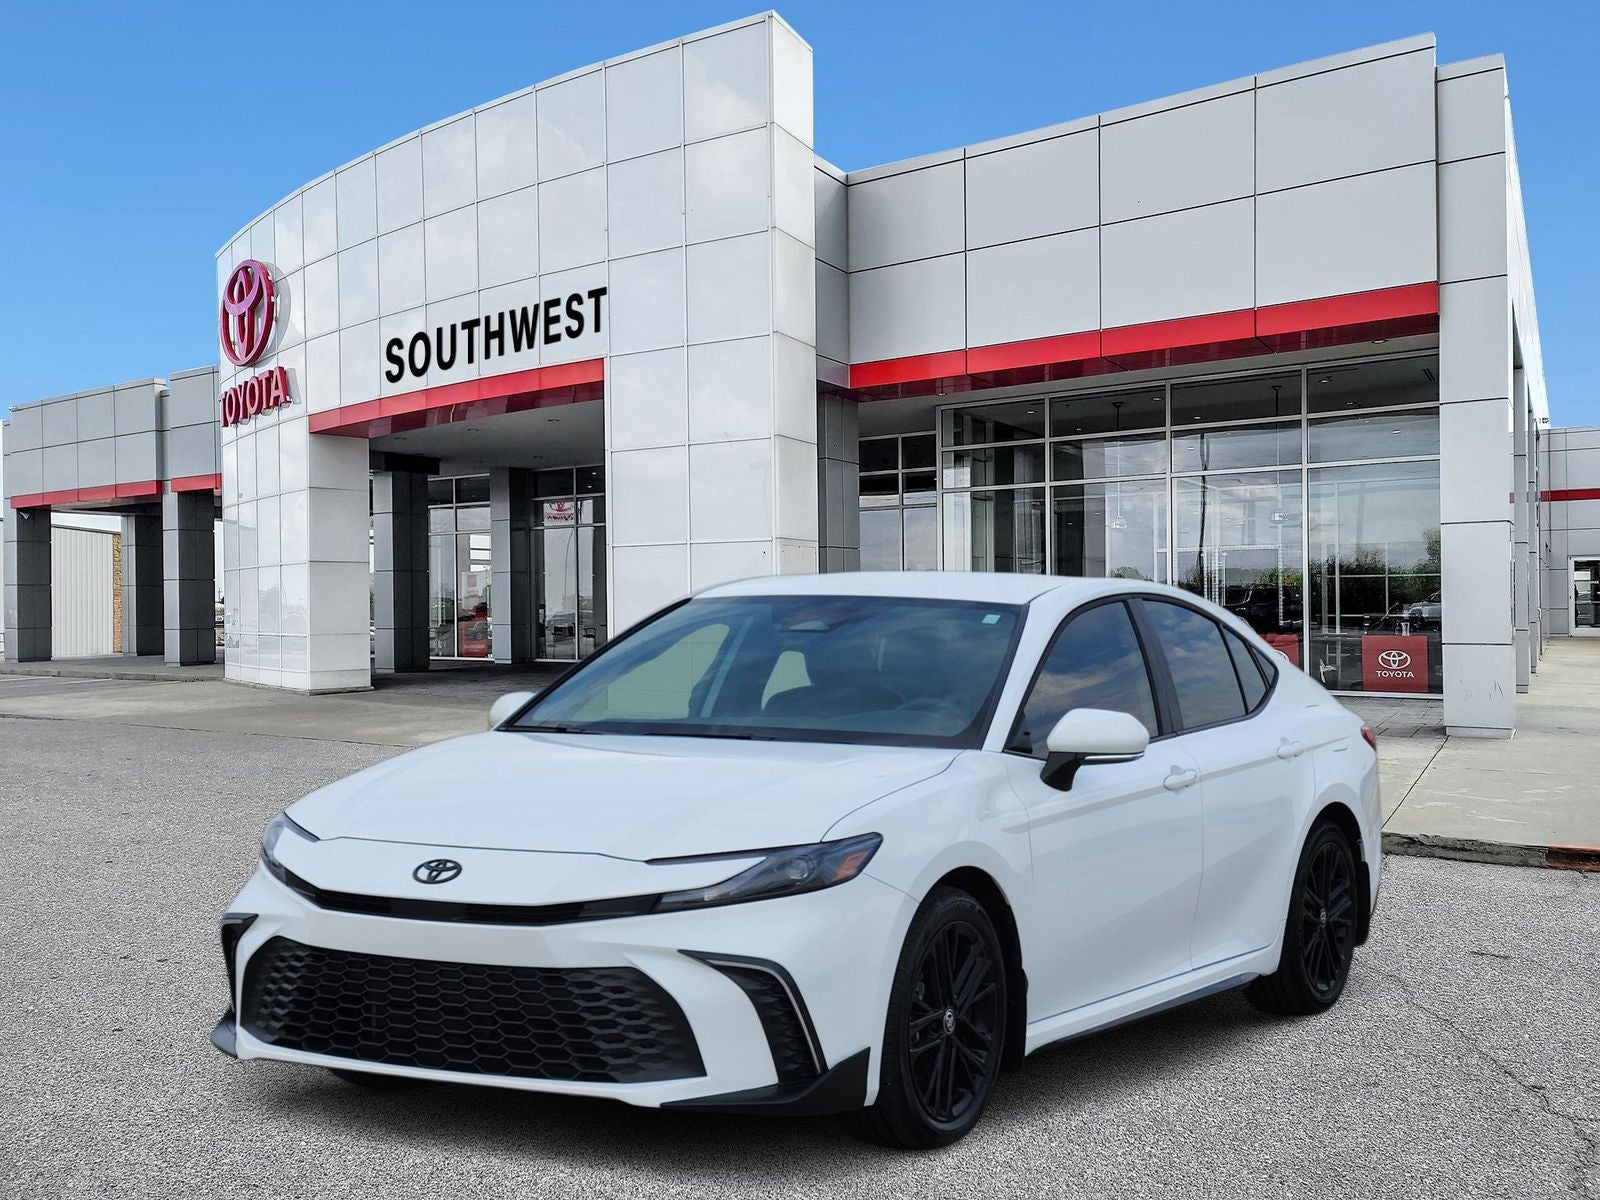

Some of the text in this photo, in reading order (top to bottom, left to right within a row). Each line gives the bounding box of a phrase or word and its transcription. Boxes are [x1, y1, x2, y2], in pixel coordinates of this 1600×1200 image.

[385, 286, 607, 383] SOUTHWEST
[218, 366, 290, 427] TOYOTA
[1376, 670, 1414, 678] TOYOTA
